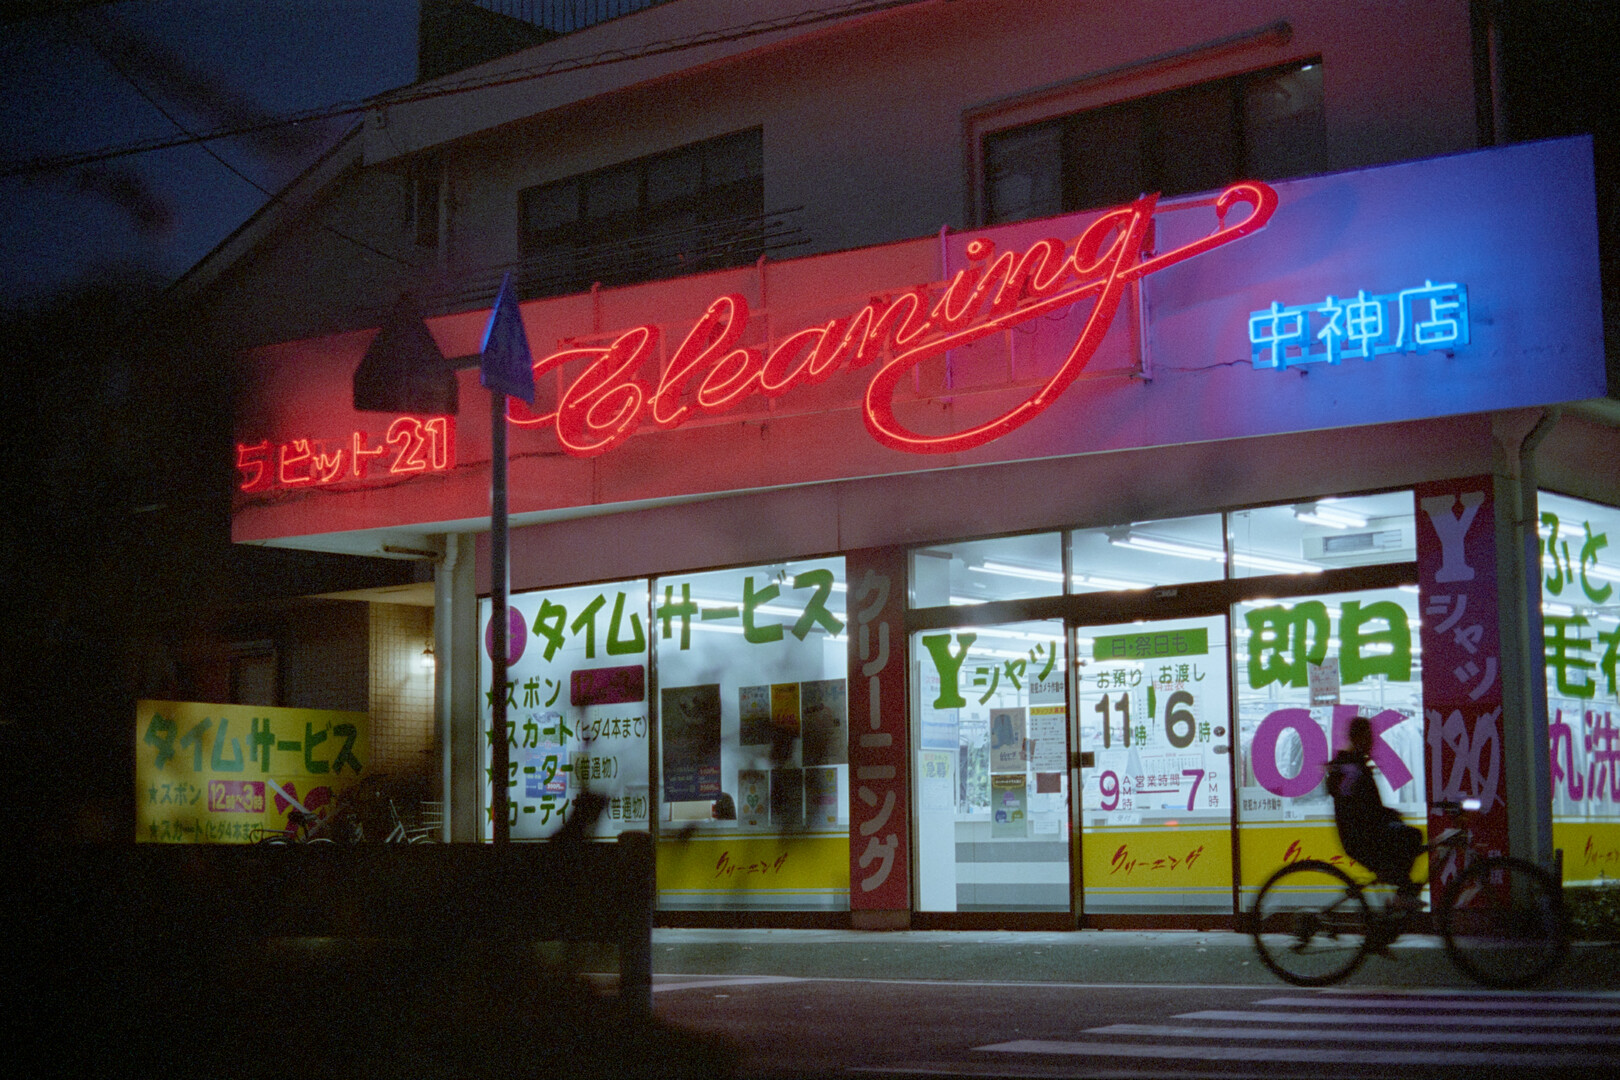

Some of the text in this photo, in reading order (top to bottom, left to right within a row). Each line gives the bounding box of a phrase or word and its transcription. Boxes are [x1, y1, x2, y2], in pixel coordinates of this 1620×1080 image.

[506, 180, 1278, 453] Cleaning
[1249, 279, 1465, 369] 中神店
[532, 569, 844, 662] タイムサービス
[1420, 491, 1497, 701] Yシャツ
[922, 632, 1056, 709] Yシャツ
[1097, 668, 1142, 688] お預り
[1159, 663, 1206, 685] お渡し
[1244, 600, 1412, 689] 即日
[144, 711, 362, 775] タイムサービス
[855, 569, 898, 892] クリーニング
[1251, 704, 1413, 798] OK
[1135, 773, 1180, 788] 営業時間
[716, 851, 788, 878] クリーニング
[1111, 844, 1204, 875] クリーニング
